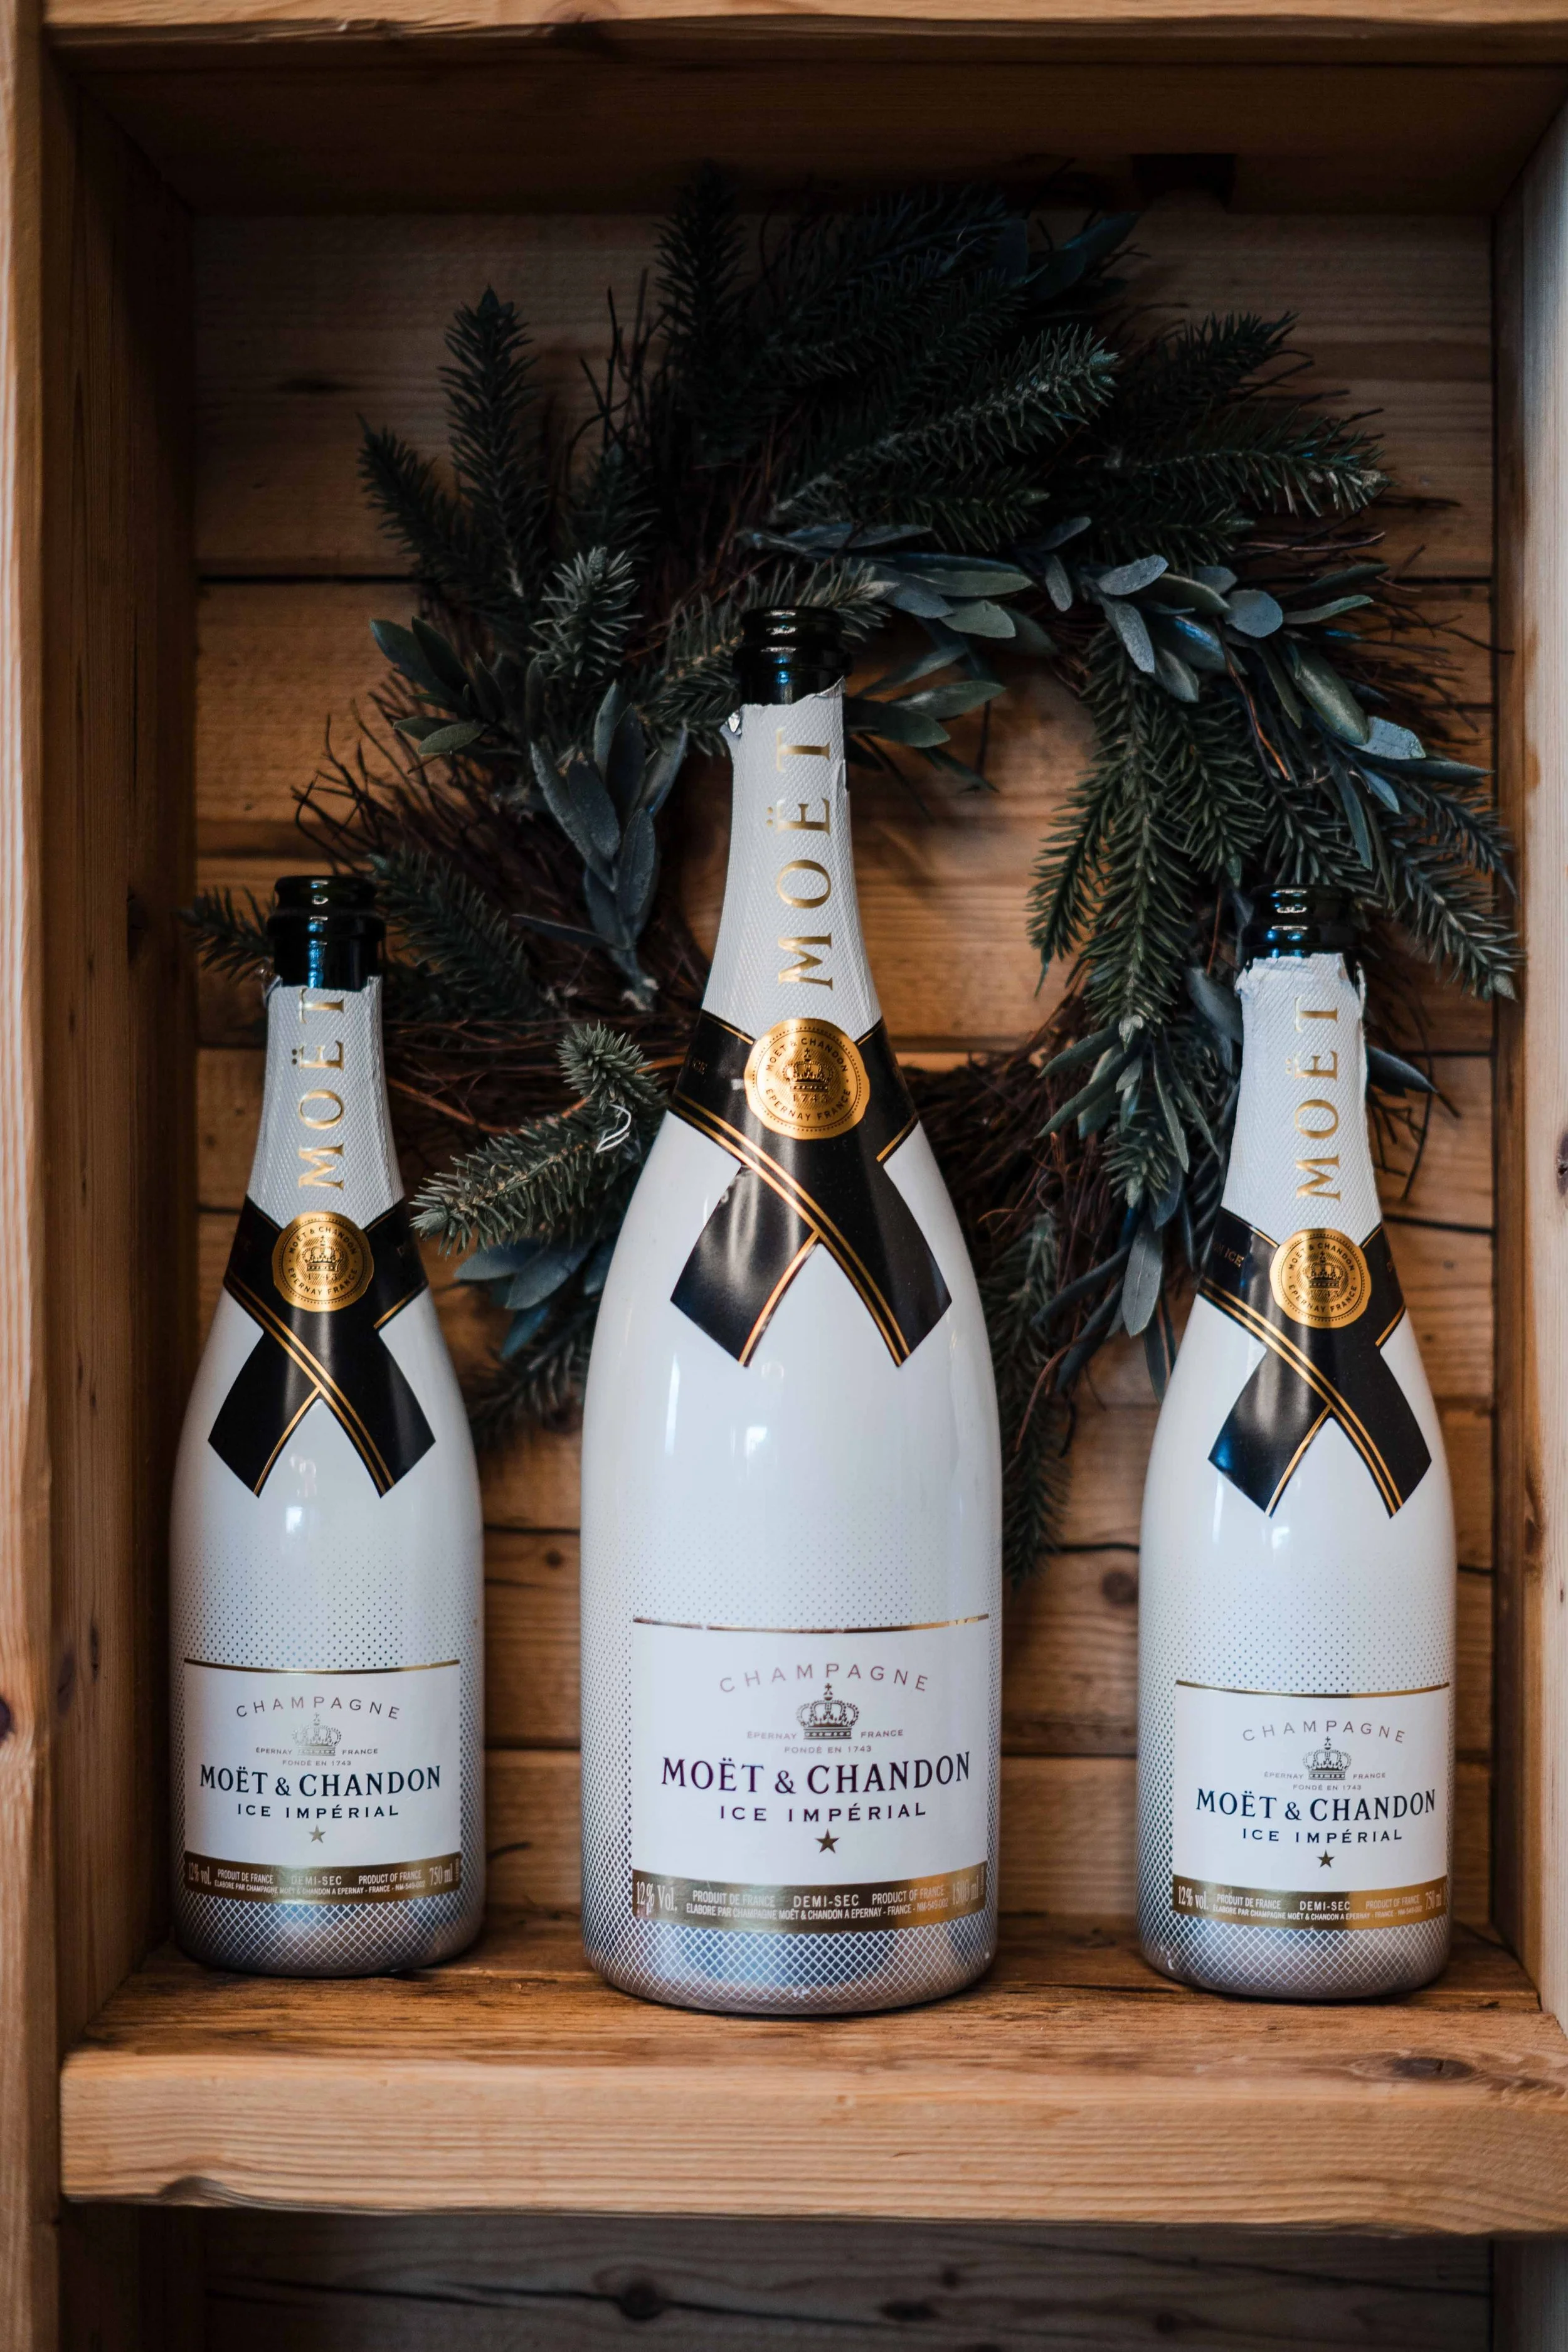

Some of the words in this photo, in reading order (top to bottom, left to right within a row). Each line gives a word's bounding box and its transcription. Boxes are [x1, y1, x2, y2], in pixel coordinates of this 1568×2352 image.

[766, 726, 834, 991] MOËT
[801, 1037, 848, 1073] CHANDON
[291, 987, 344, 1192] MOËT
[792, 1093, 829, 1103] 1743
[1285, 996, 1342, 1202] MOËT
[766, 1089, 812, 1122] EPERNAY
[817, 1089, 851, 1120] FRANCE
[319, 1226, 357, 1254] CHANDON
[1317, 1242, 1355, 1271] CHANDON
[288, 1267, 323, 1296] EPERNAY
[327, 1269, 357, 1295] FRANCE
[1289, 1284, 1325, 1313] EPERNAY
[1330, 1285, 1357, 1313] FRANCE
[719, 1663, 929, 1693] CHAMPAGNE
[236, 1696, 400, 1720] CHAMPAGNE
[747, 1731, 797, 1740] ÉPERNAY
[860, 1729, 904, 1739] FRANCE
[1242, 1720, 1406, 1744] CHAMPAGNE
[256, 1747, 293, 1755] ÉPERNAY
[784, 1745, 823, 1754] FONDÉ
[848, 1745, 872, 1754] 1743
[199, 1764, 268, 1794] MOËT
[275, 1777, 292, 1796] &
[299, 1765, 441, 1798] CHANDON
[661, 1757, 765, 1793] MOËT
[775, 1770, 797, 1794] &
[807, 1752, 970, 1794] CHANDON
[1264, 1771, 1304, 1779] ÉPERNAY
[238, 1803, 271, 1817] ICE
[286, 1803, 400, 1819] IMPÉRIAL
[720, 1805, 767, 1821] ICE
[788, 1802, 927, 1823] IMPÉRIAL
[1195, 1788, 1277, 1819] MOËT
[1285, 1801, 1302, 1821] &
[1310, 1789, 1436, 1821] CHANDON
[1243, 1828, 1279, 1842] ICE
[1295, 1829, 1403, 1844] IMPÉRIAL
[218, 1868, 241, 1881] PRODUIT
[241, 1872, 250, 1882] DE
[250, 1873, 274, 1884] FRANCE
[291, 1875, 342, 1885] DEMI-SEC
[358, 1874, 388, 1885] PRODUCT
[389, 1873, 398, 1883] OF
[400, 1869, 422, 1881] FRANCE
[429, 1865, 443, 1886] 750
[444, 1863, 453, 1883] ml
[236, 1883, 246, 1891] PAR
[246, 1883, 279, 1894] CHAMPAGNE
[337, 1887, 364, 1895] EPERNAY
[369, 1884, 391, 1893] FRANCE
[636, 1881, 655, 1907] 12%
[657, 1884, 678, 1912] Vol.
[692, 1890, 727, 1905] PRODUIT
[729, 1893, 741, 1905] DE
[743, 1895, 776, 1907] FRANCE
[872, 1890, 907, 1905] PRODUCT
[909, 1889, 918, 1900] OF
[920, 1884, 944, 1899] FRANCE
[1178, 1885, 1193, 1907] 12%
[793, 1894, 859, 1908] DEMI-SEC
[1217, 1894, 1244, 1906] PRODUIT
[1245, 1897, 1254, 1907] DE
[1255, 1899, 1281, 1910] FRANCE
[1300, 1900, 1350, 1911] DEMI-SEC
[1365, 1899, 1392, 1910] PRODUCT
[1394, 1898, 1400, 1907] OF
[718, 1905, 732, 1917] PAR
[733, 1907, 778, 1920] CHAMPAGNE
[800, 1910, 807, 1920] &
[808, 1909, 843, 1920] CHANDON
[851, 1907, 882, 1919] EPERNAY
[887, 1904, 912, 1916] FRANCE
[1238, 1908, 1249, 1917] PAR
[1250, 1909, 1286, 1919] CHAMPAGNE
